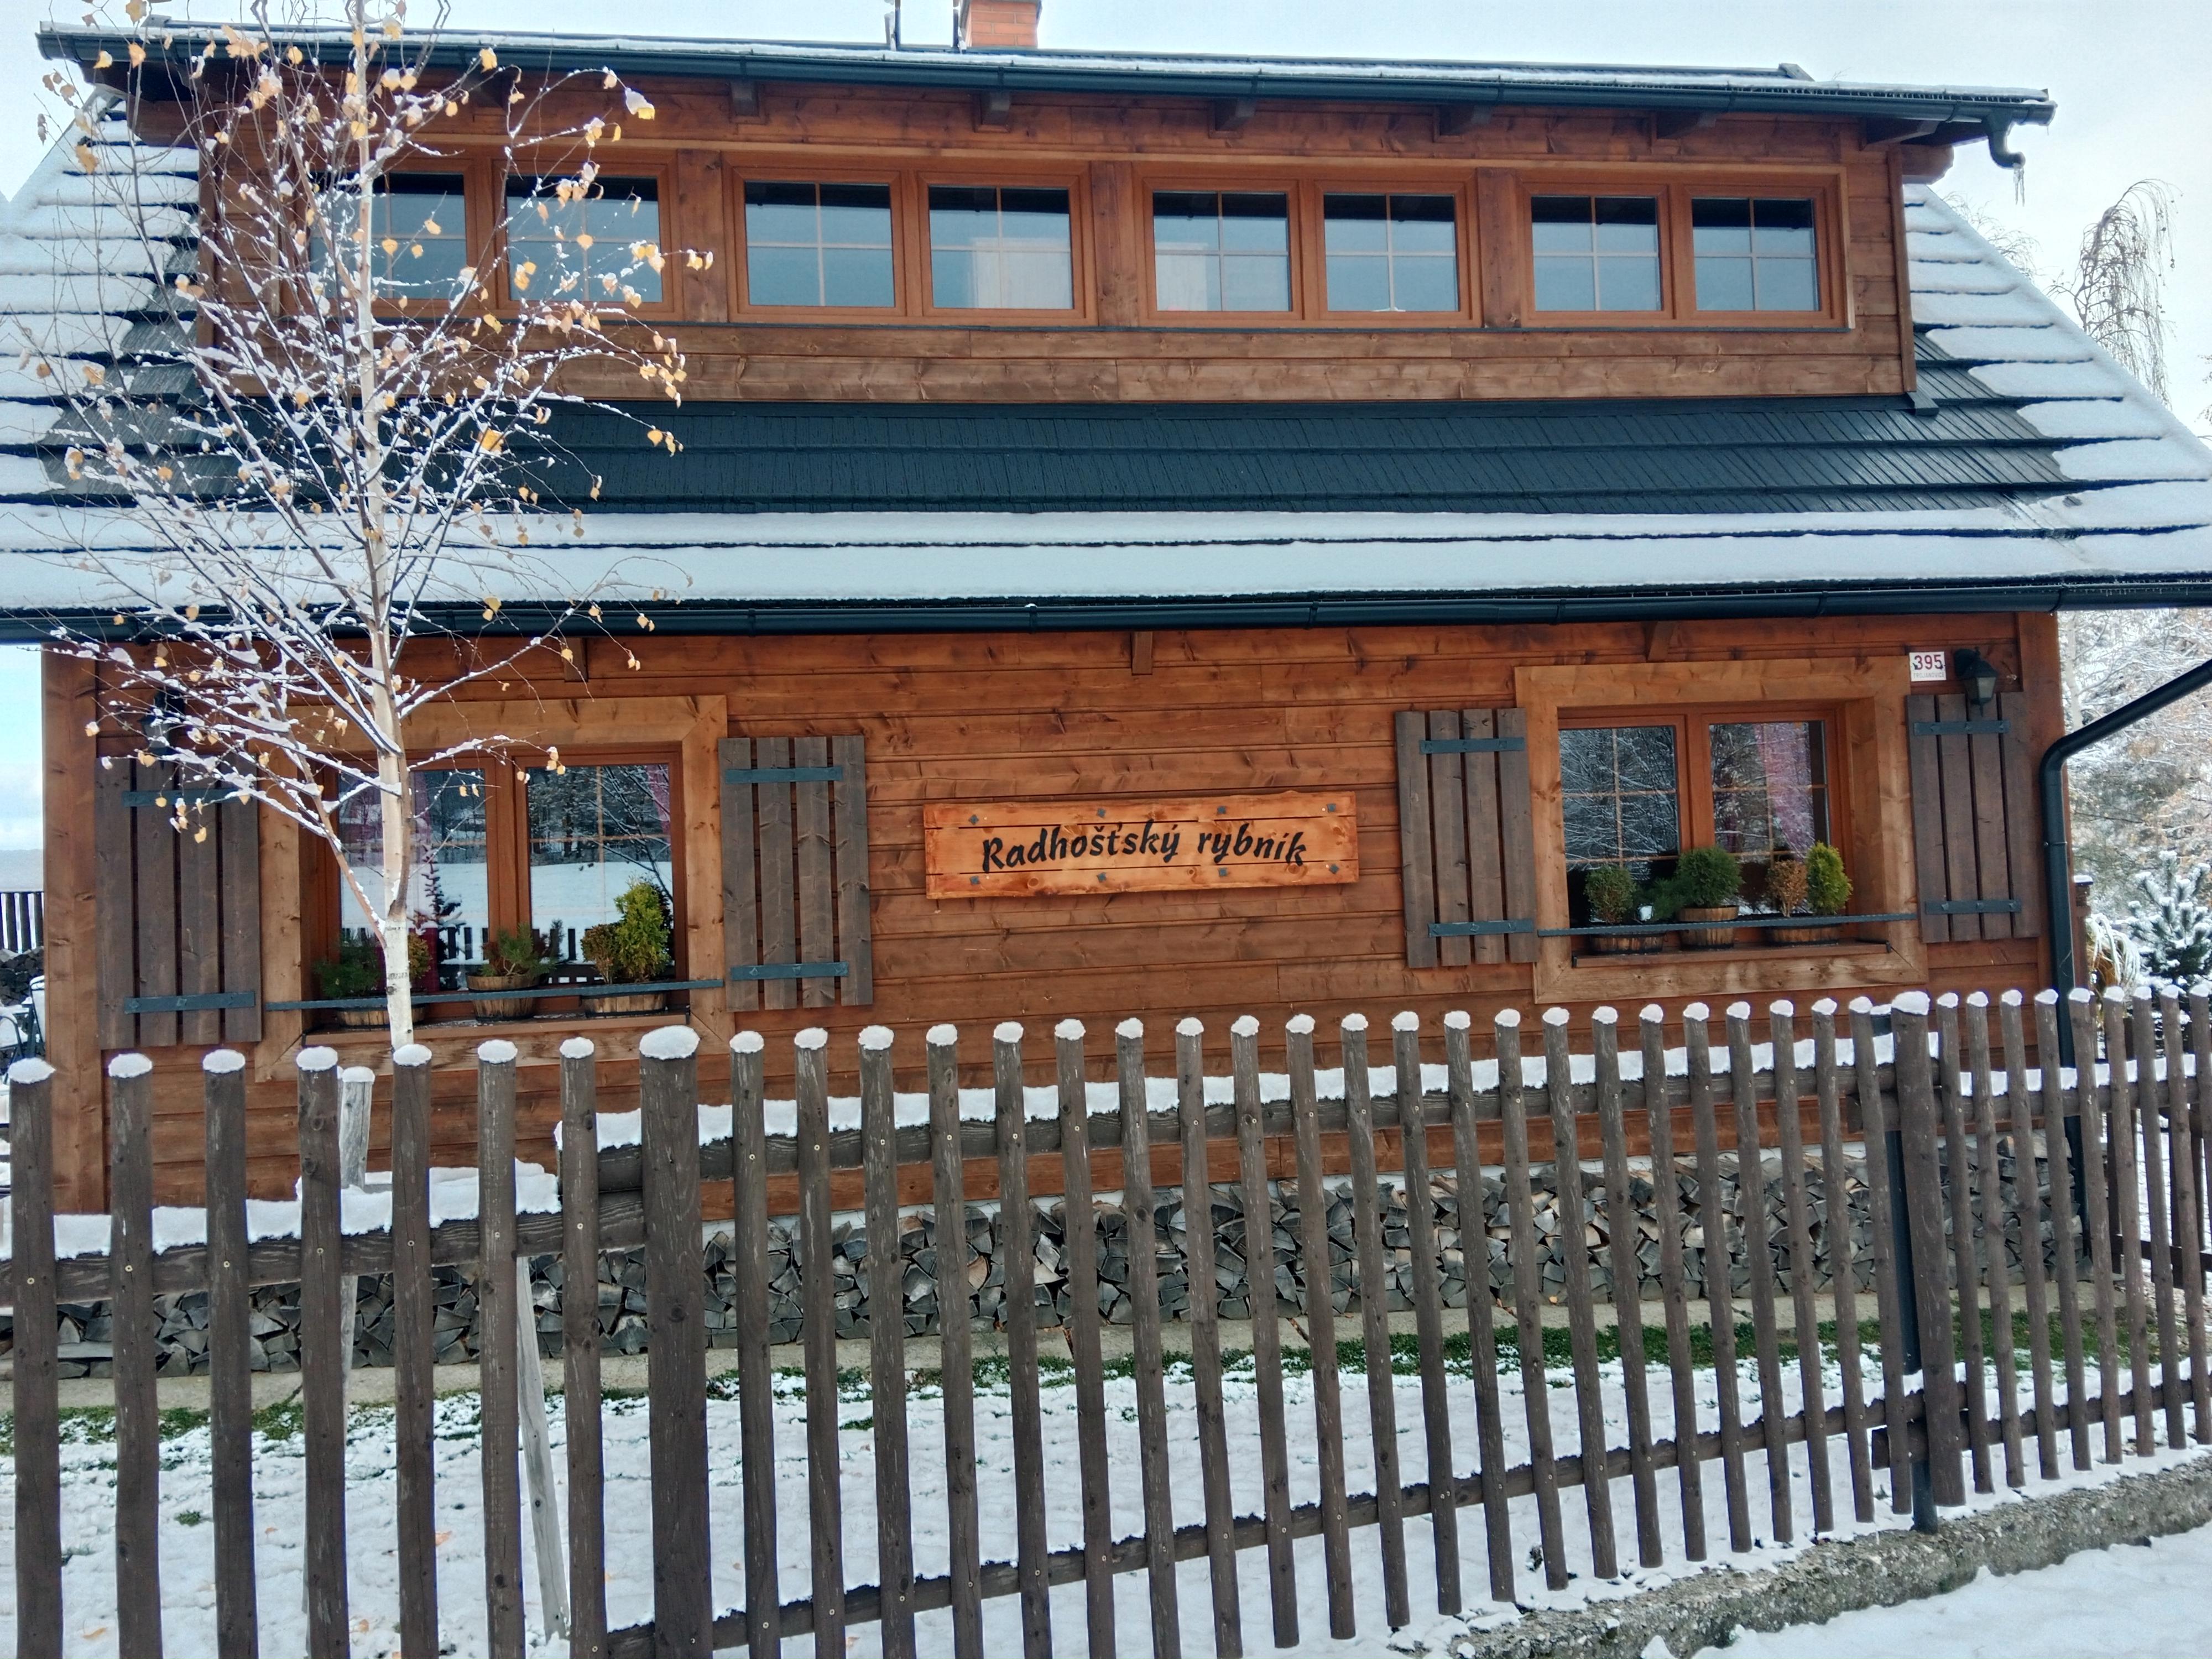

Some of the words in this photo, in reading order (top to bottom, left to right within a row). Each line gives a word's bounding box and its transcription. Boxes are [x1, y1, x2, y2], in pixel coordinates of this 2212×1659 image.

[1914, 654, 1943, 670] 395
[982, 818, 1180, 874] Radhošťský
[1197, 823, 1306, 866] rybník
